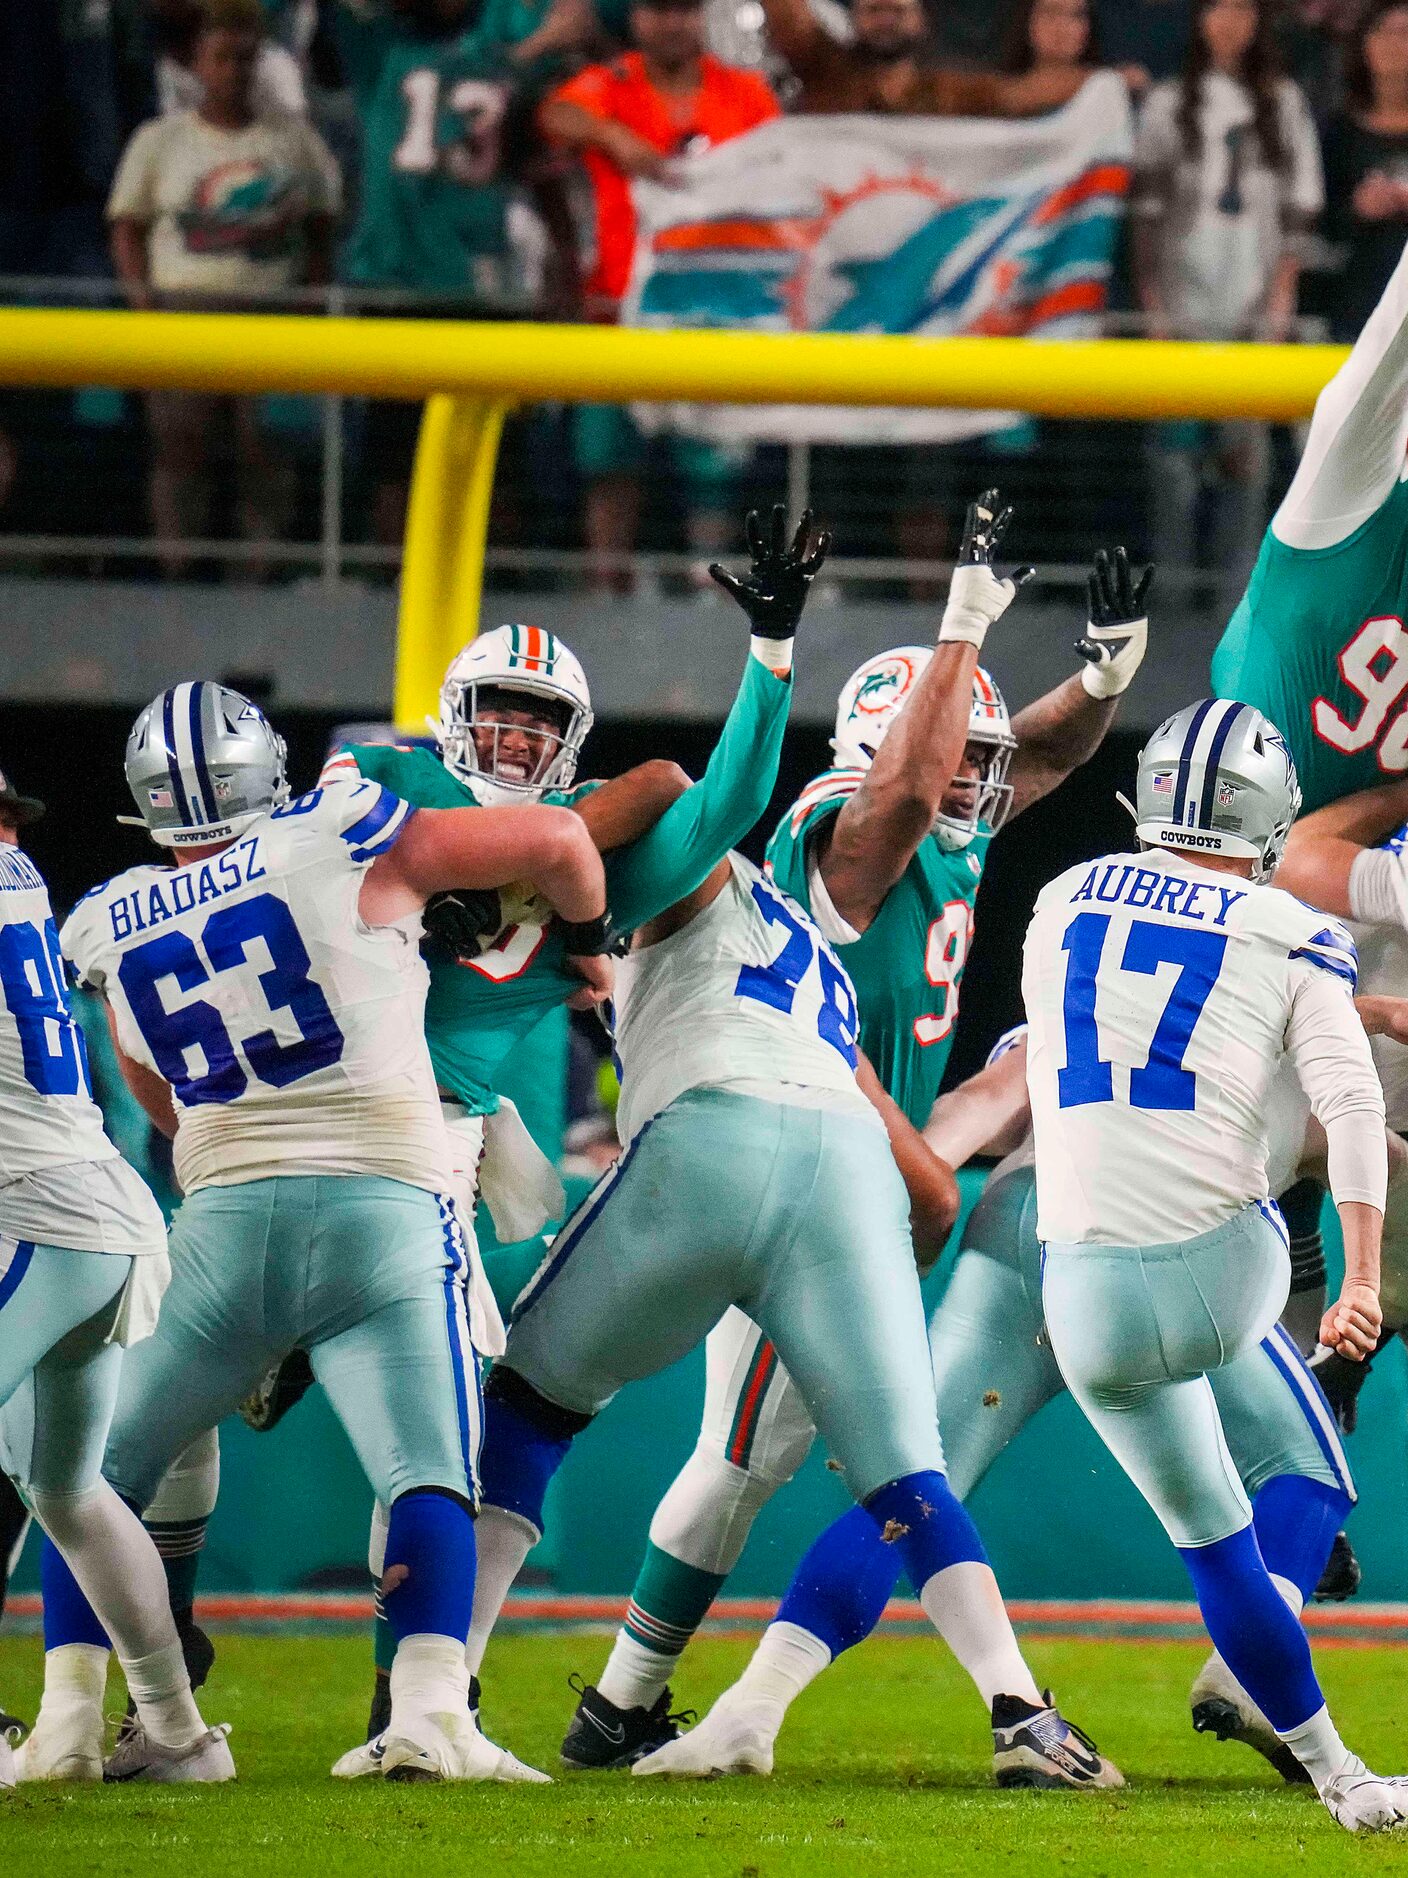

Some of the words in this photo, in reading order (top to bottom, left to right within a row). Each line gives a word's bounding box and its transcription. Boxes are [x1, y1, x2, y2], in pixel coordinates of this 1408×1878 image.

[174, 825, 232, 842] COWBOYS
[1160, 830, 1222, 850] COWBOYS
[108, 837, 266, 943] BIADASZ
[1070, 864, 1248, 927] AUBREY
[118, 892, 345, 1108] 63
[1058, 911, 1229, 1112] 17
